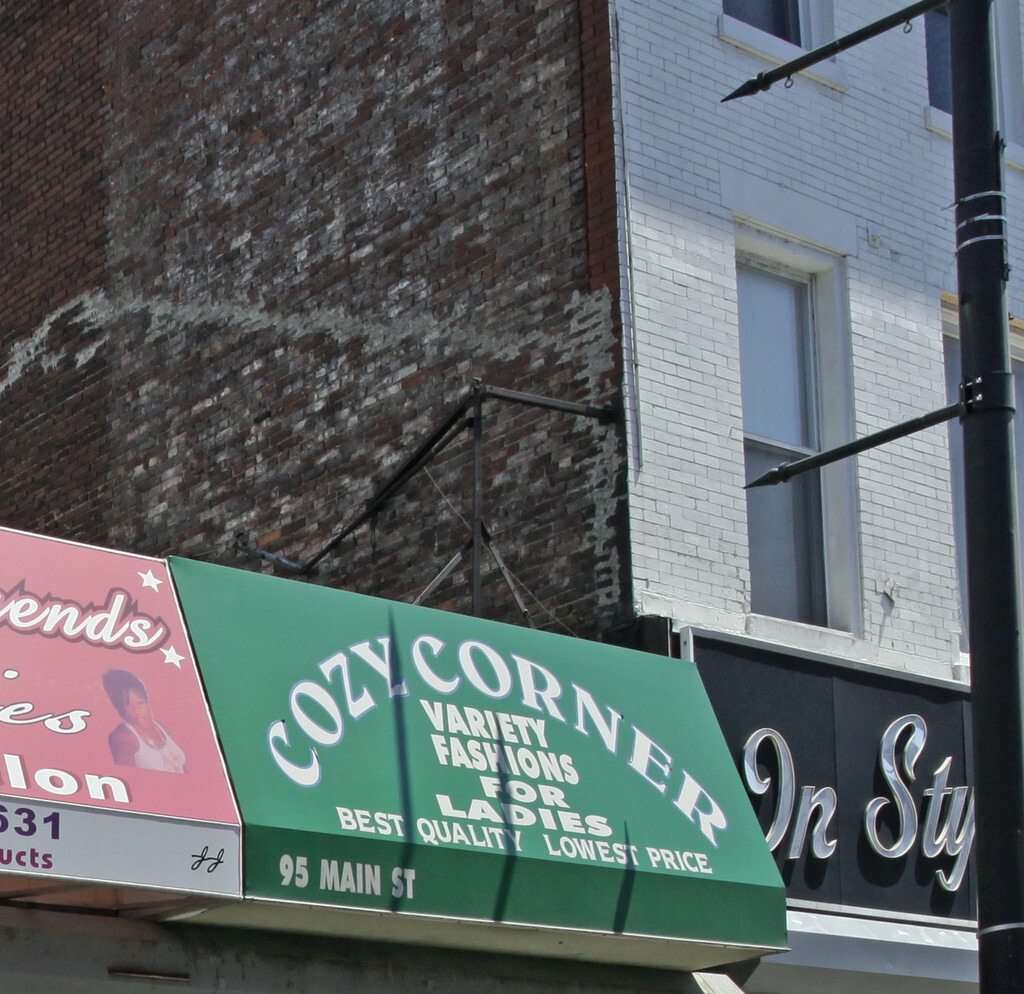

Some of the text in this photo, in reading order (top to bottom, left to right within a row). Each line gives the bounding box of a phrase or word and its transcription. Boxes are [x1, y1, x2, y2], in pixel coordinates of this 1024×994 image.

[267, 635, 728, 847] COZY CORNER
[419, 699, 548, 748] VARIETY
[431, 734, 579, 786] FASHIONS
[436, 794, 613, 838] LADIES
[479, 775, 571, 809] FOR
[743, 728, 838, 859] In
[337, 805, 714, 875] BEST QUALITY LOWEST PRICE
[279, 855, 416, 900] 95 MAIN ST
